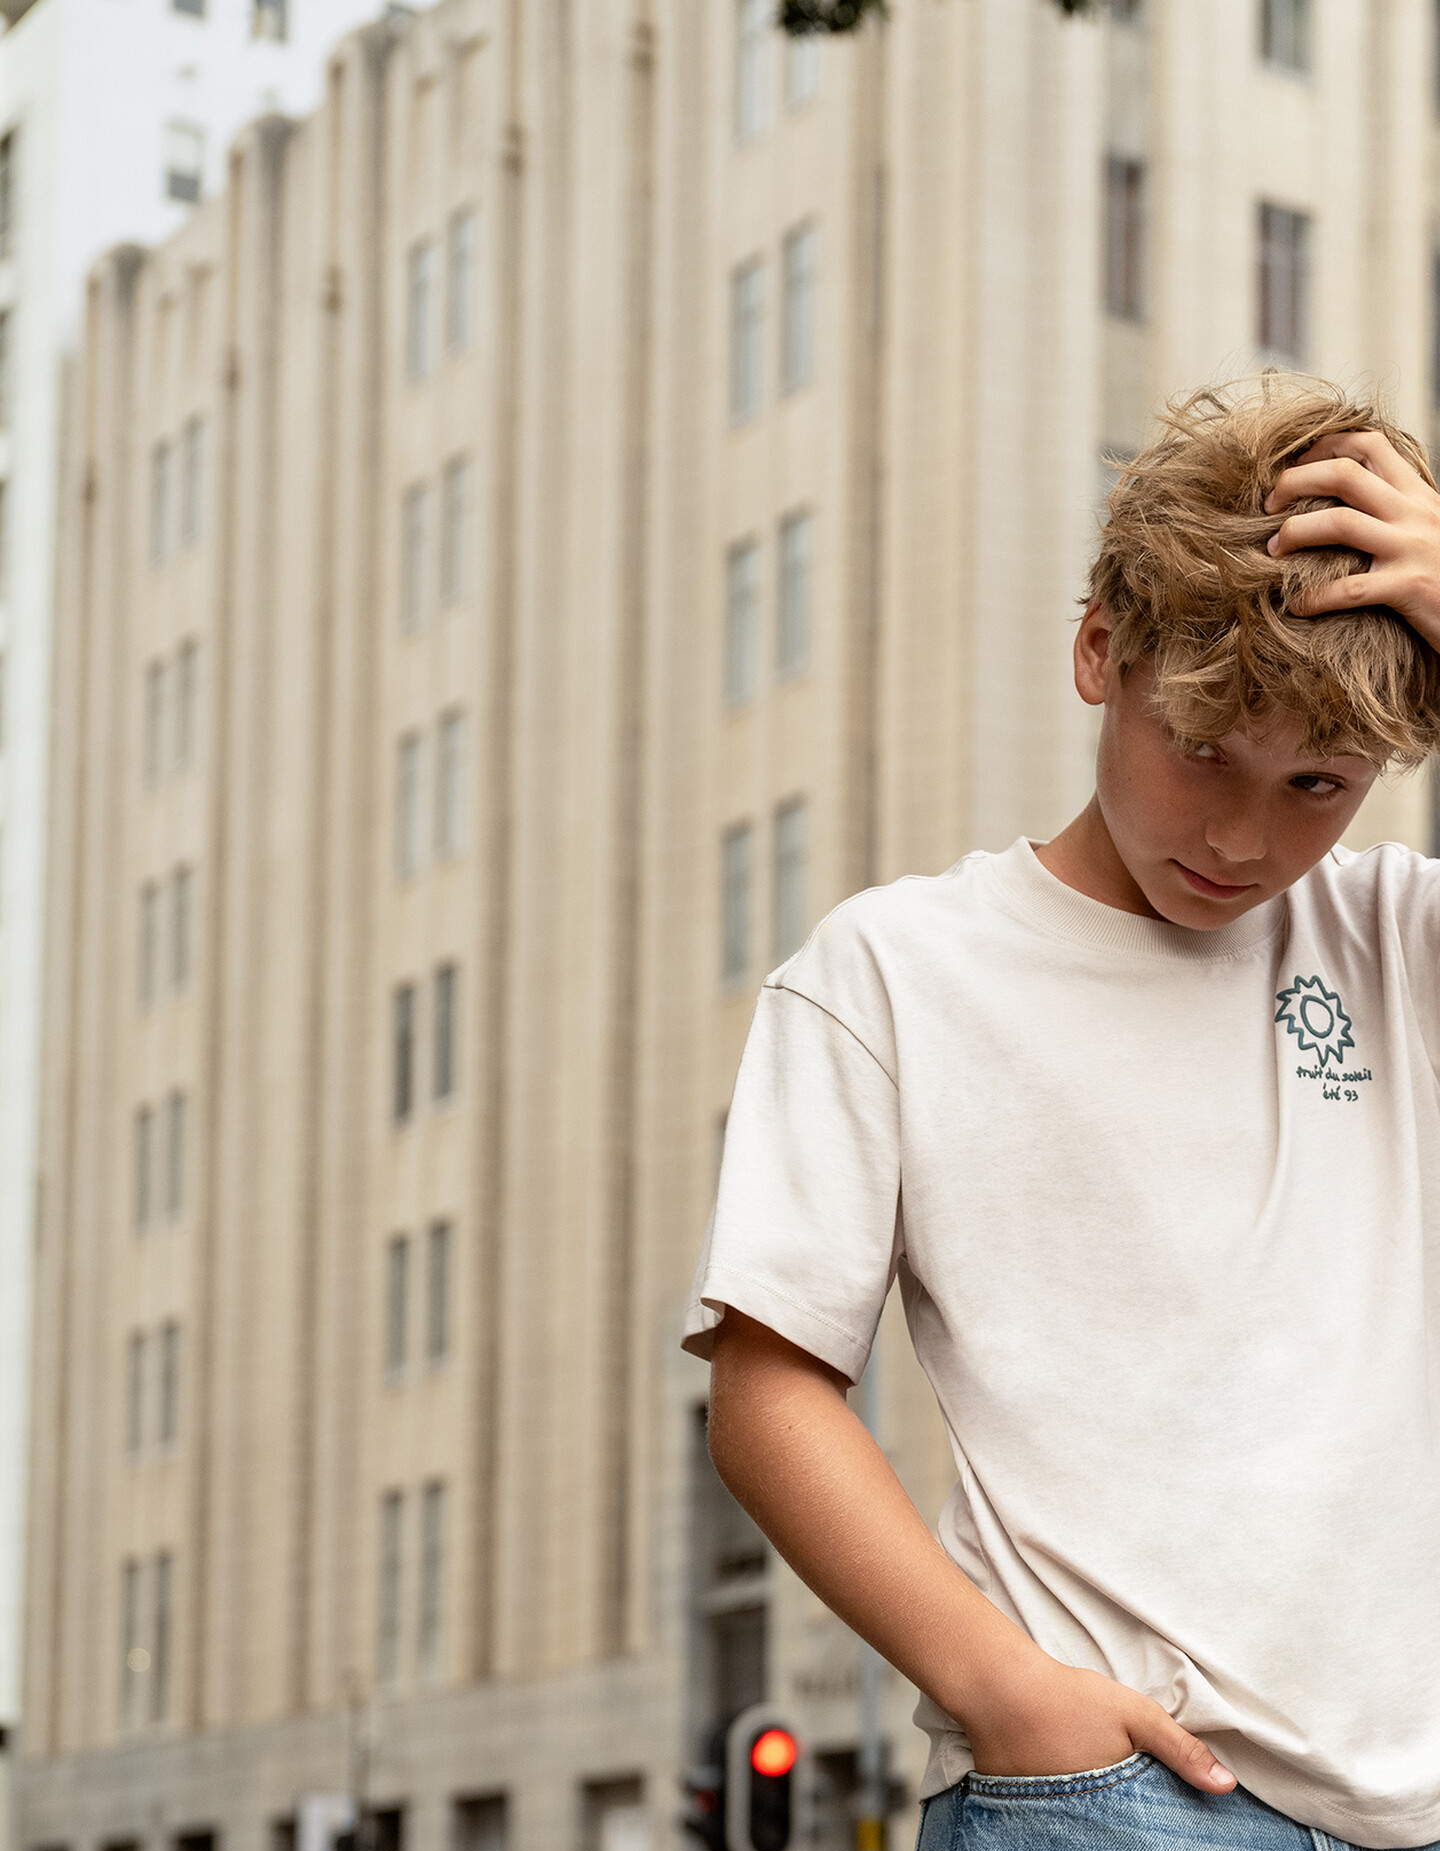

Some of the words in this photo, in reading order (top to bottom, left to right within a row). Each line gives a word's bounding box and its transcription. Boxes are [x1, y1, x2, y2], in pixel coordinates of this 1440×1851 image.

[1296, 1065, 1324, 1079] fruit
[1325, 1067, 1340, 1081] du
[1342, 1068, 1372, 1082] soleil
[1344, 1090, 1358, 1101] 93
